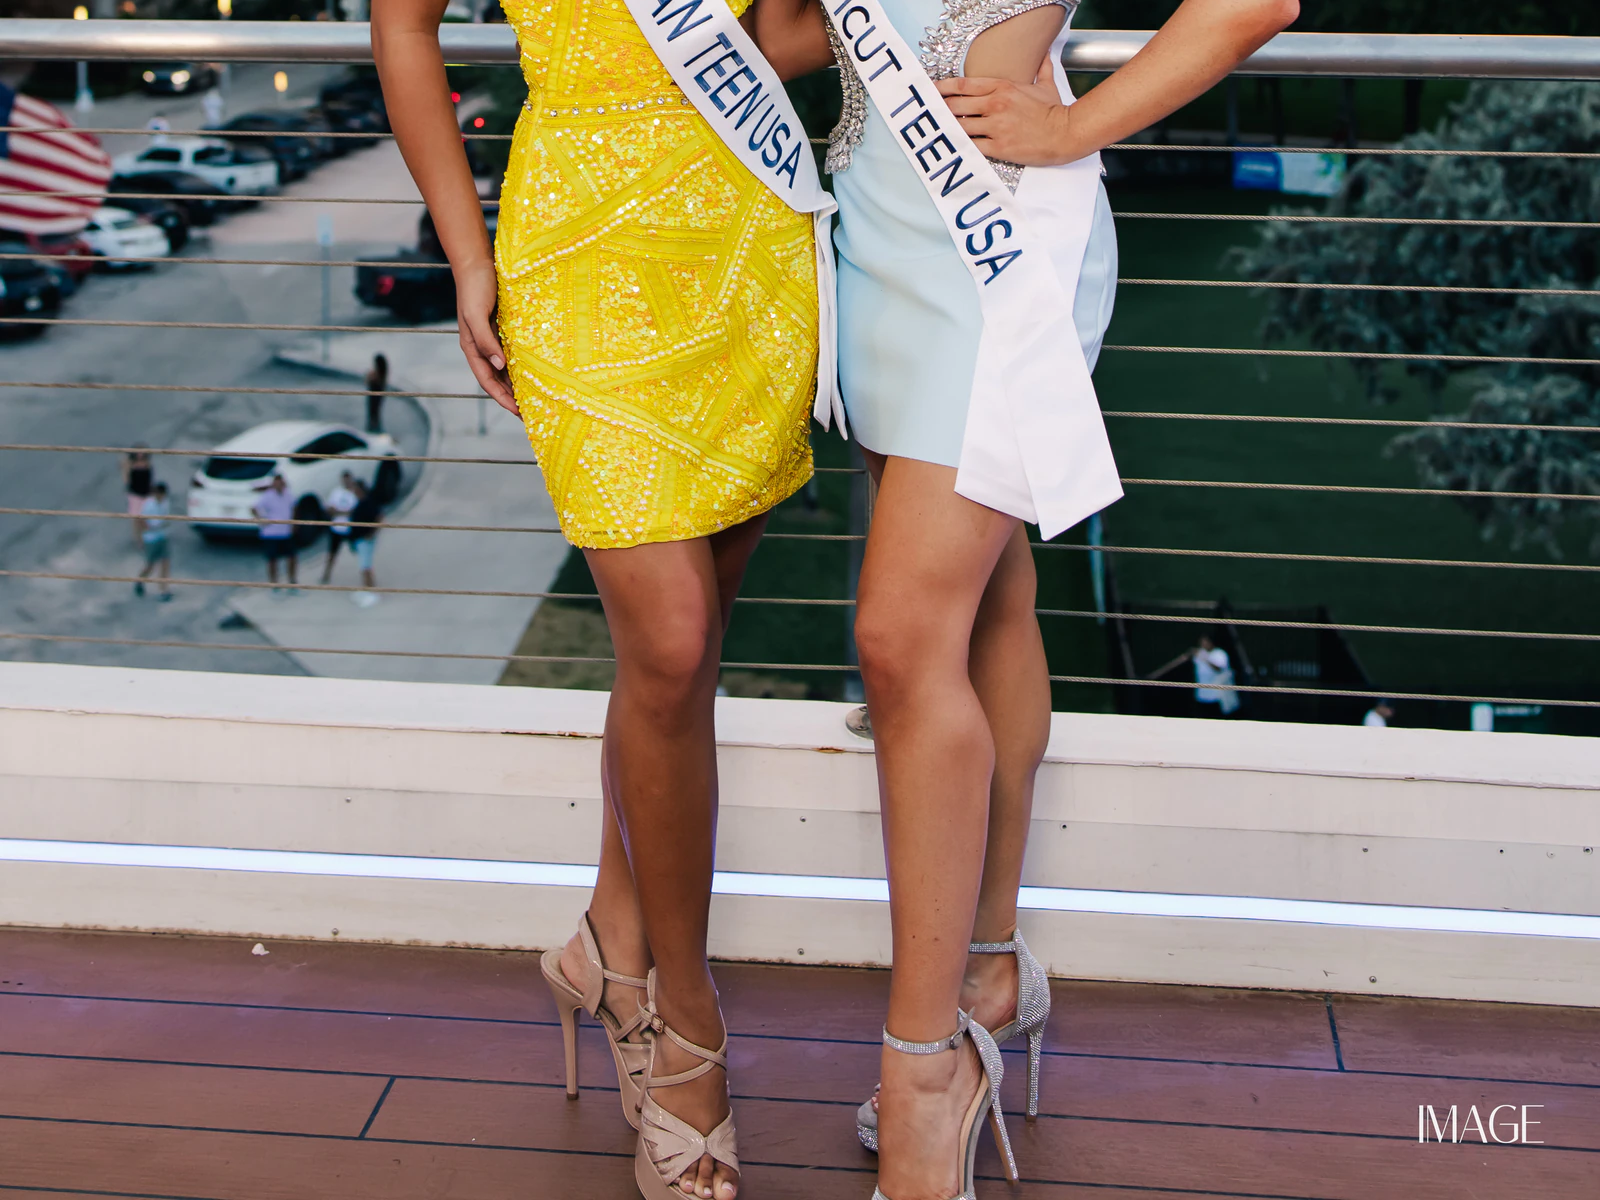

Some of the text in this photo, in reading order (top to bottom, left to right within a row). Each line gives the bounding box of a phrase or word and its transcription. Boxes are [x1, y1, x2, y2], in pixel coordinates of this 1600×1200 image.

[683, 32, 770, 131] TEEN
[748, 103, 803, 189] USA
[890, 84, 974, 198] TEEN
[955, 191, 1023, 286] USA
